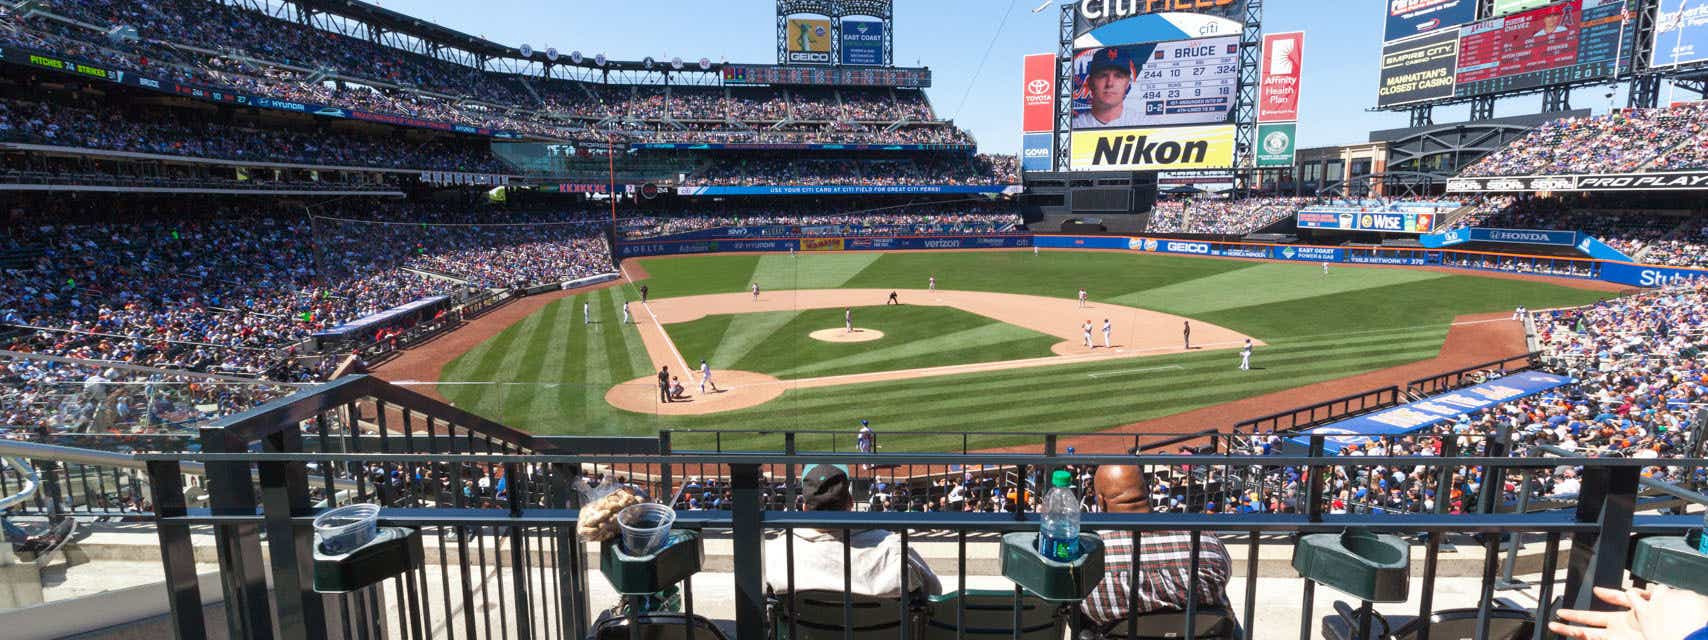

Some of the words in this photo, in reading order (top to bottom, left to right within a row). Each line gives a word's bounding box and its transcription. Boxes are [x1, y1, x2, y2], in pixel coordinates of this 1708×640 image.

[1199, 23, 1218, 35] citi
[790, 52, 828, 61] GEICO
[1174, 46, 1217, 58] BRUCE
[1386, 51, 1425, 65] EMPIRE
[1426, 45, 1453, 56] CITY
[30, 55, 63, 69] PITCHES
[64, 61, 75, 71] 74
[77, 64, 106, 77] STRIKES
[1405, 57, 1430, 66] CASINO
[1143, 70, 1162, 79] 244
[1170, 69, 1181, 77] 10
[1192, 67, 1206, 76] 27
[1214, 65, 1236, 75] .324
[1386, 67, 1447, 86] MANHATTAN'S
[1264, 75, 1297, 87] Affinity
[1380, 81, 1417, 95] CLOSEST
[1418, 76, 1453, 89] CASINO
[1142, 91, 1161, 99] 494
[1168, 89, 1180, 98] 23
[1194, 88, 1201, 97] 9
[1266, 86, 1294, 96] Health
[1270, 95, 1288, 104] Plan
[272, 101, 305, 112] HYUNDAI
[1147, 103, 1164, 112] 0-2
[1025, 148, 1049, 156] GOYA
[1092, 134, 1209, 165] Nikon
[1578, 177, 1634, 187] PRO
[1633, 175, 1708, 187] PLAY
[1500, 232, 1551, 242] HONDA
[924, 239, 960, 249] verizon
[1167, 242, 1208, 253] GEICO
[1369, 257, 1401, 265] NETWORK
